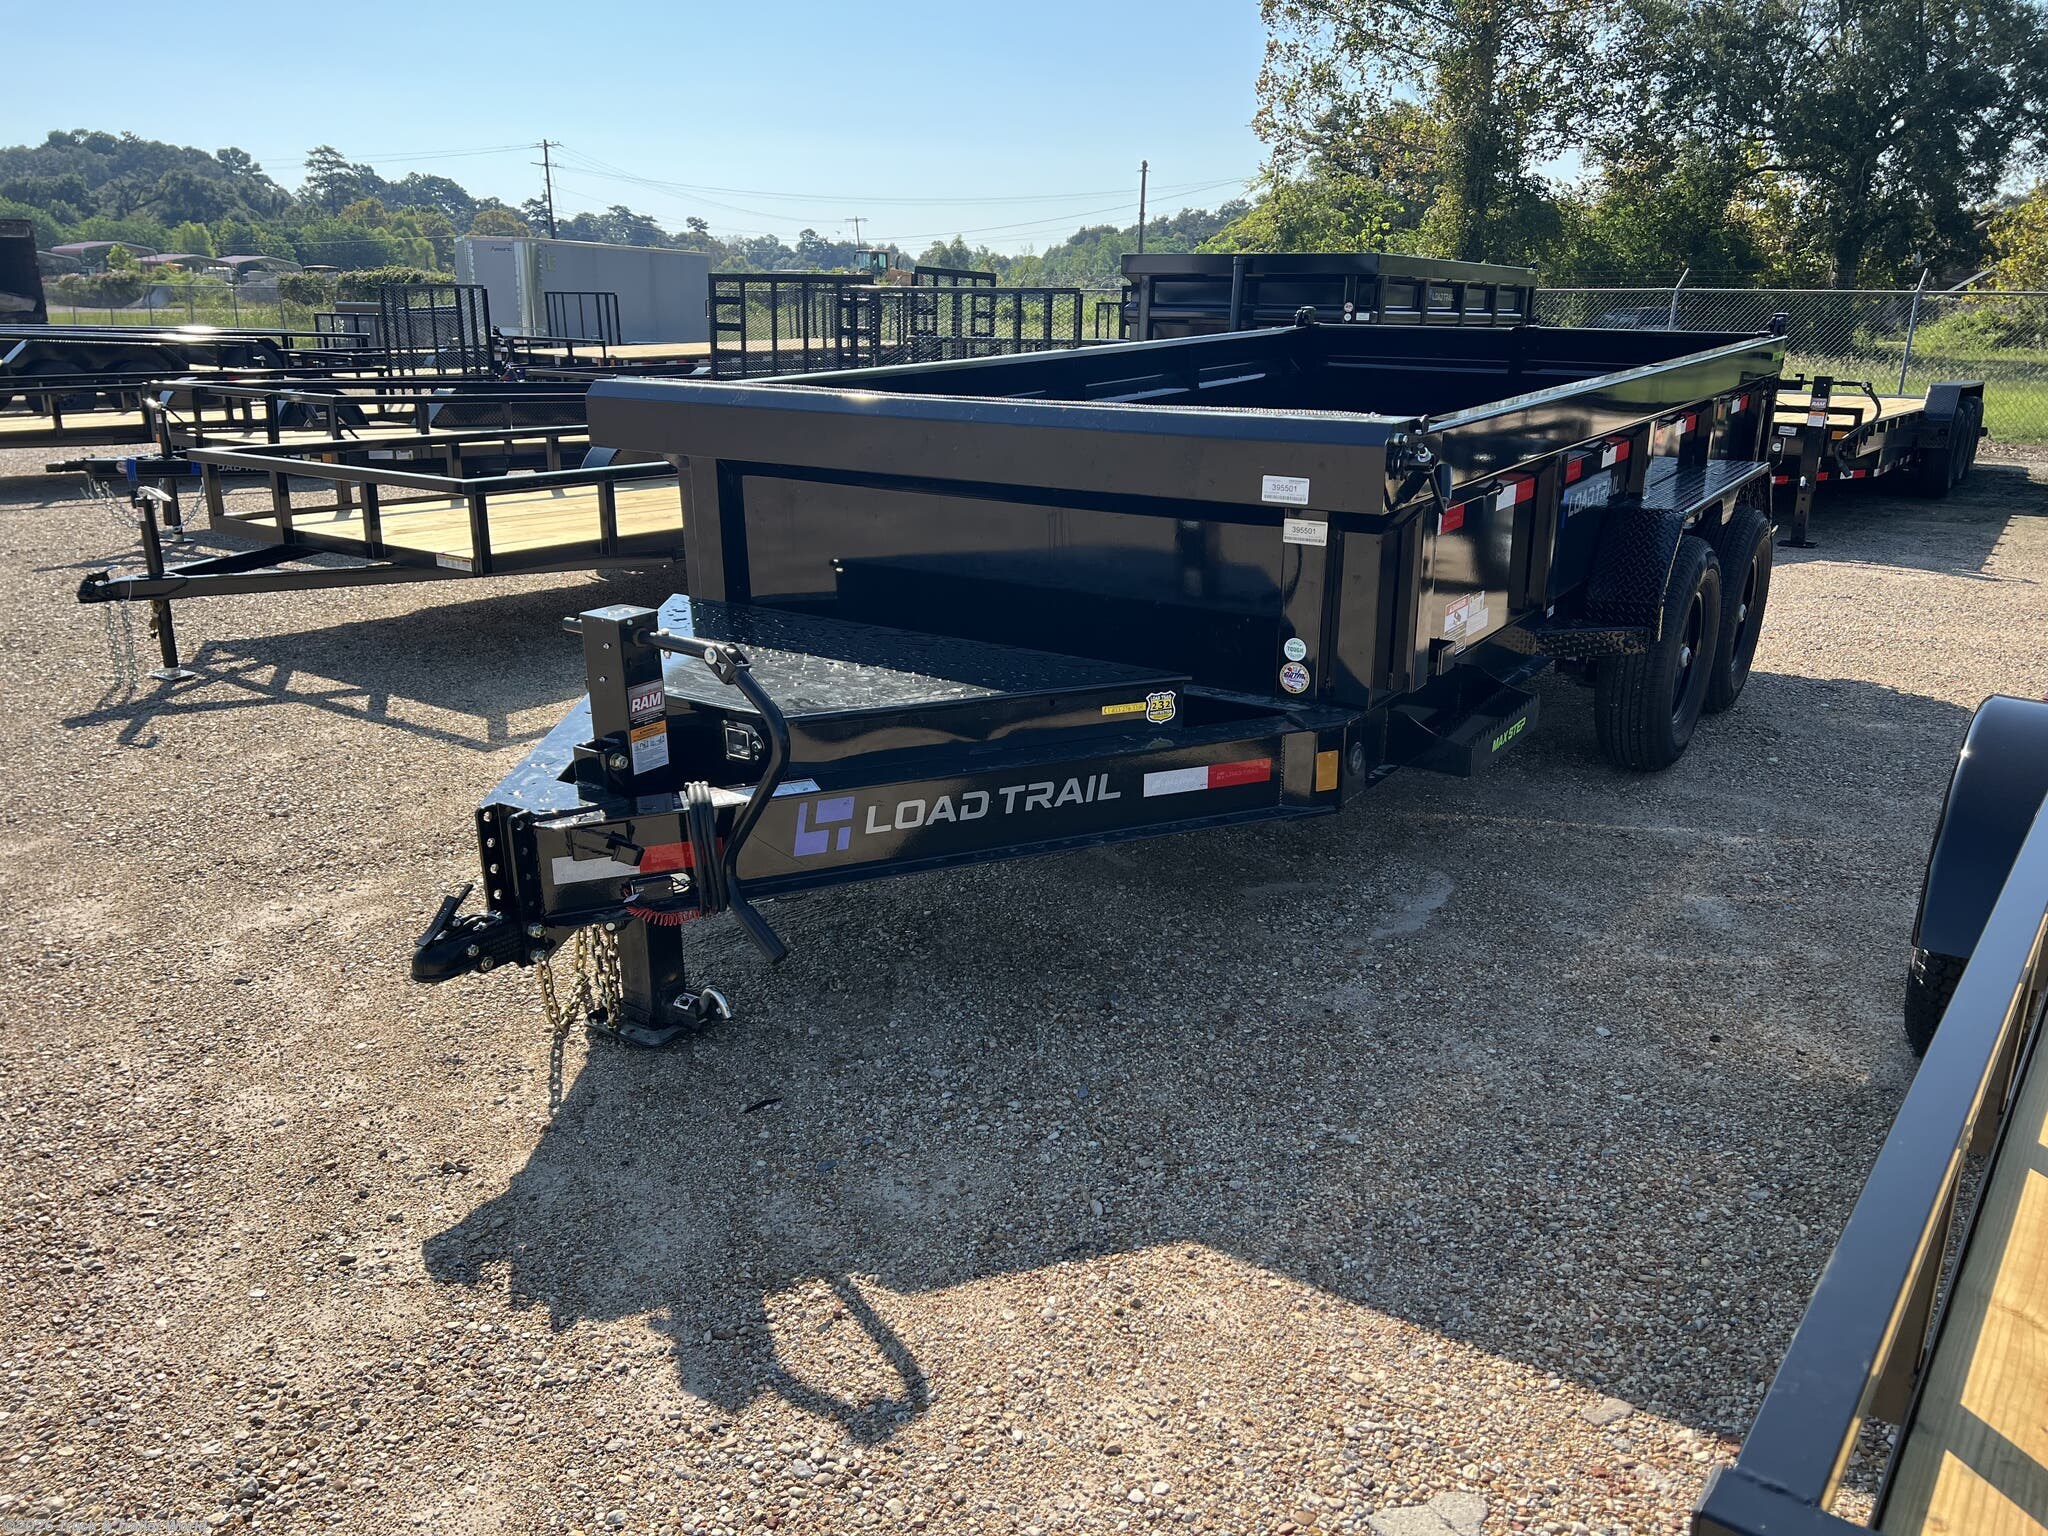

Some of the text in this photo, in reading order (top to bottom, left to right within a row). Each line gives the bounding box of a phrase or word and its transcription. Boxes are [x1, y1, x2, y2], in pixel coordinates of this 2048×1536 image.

[1271, 483, 1297, 493] 395501
[1291, 525, 1316, 535] 395501
[631, 691, 662, 713] RAM
[1492, 717, 1527, 753] MAX STEP
[864, 790, 990, 835] LOAD
[998, 773, 1122, 815] TRAIL
